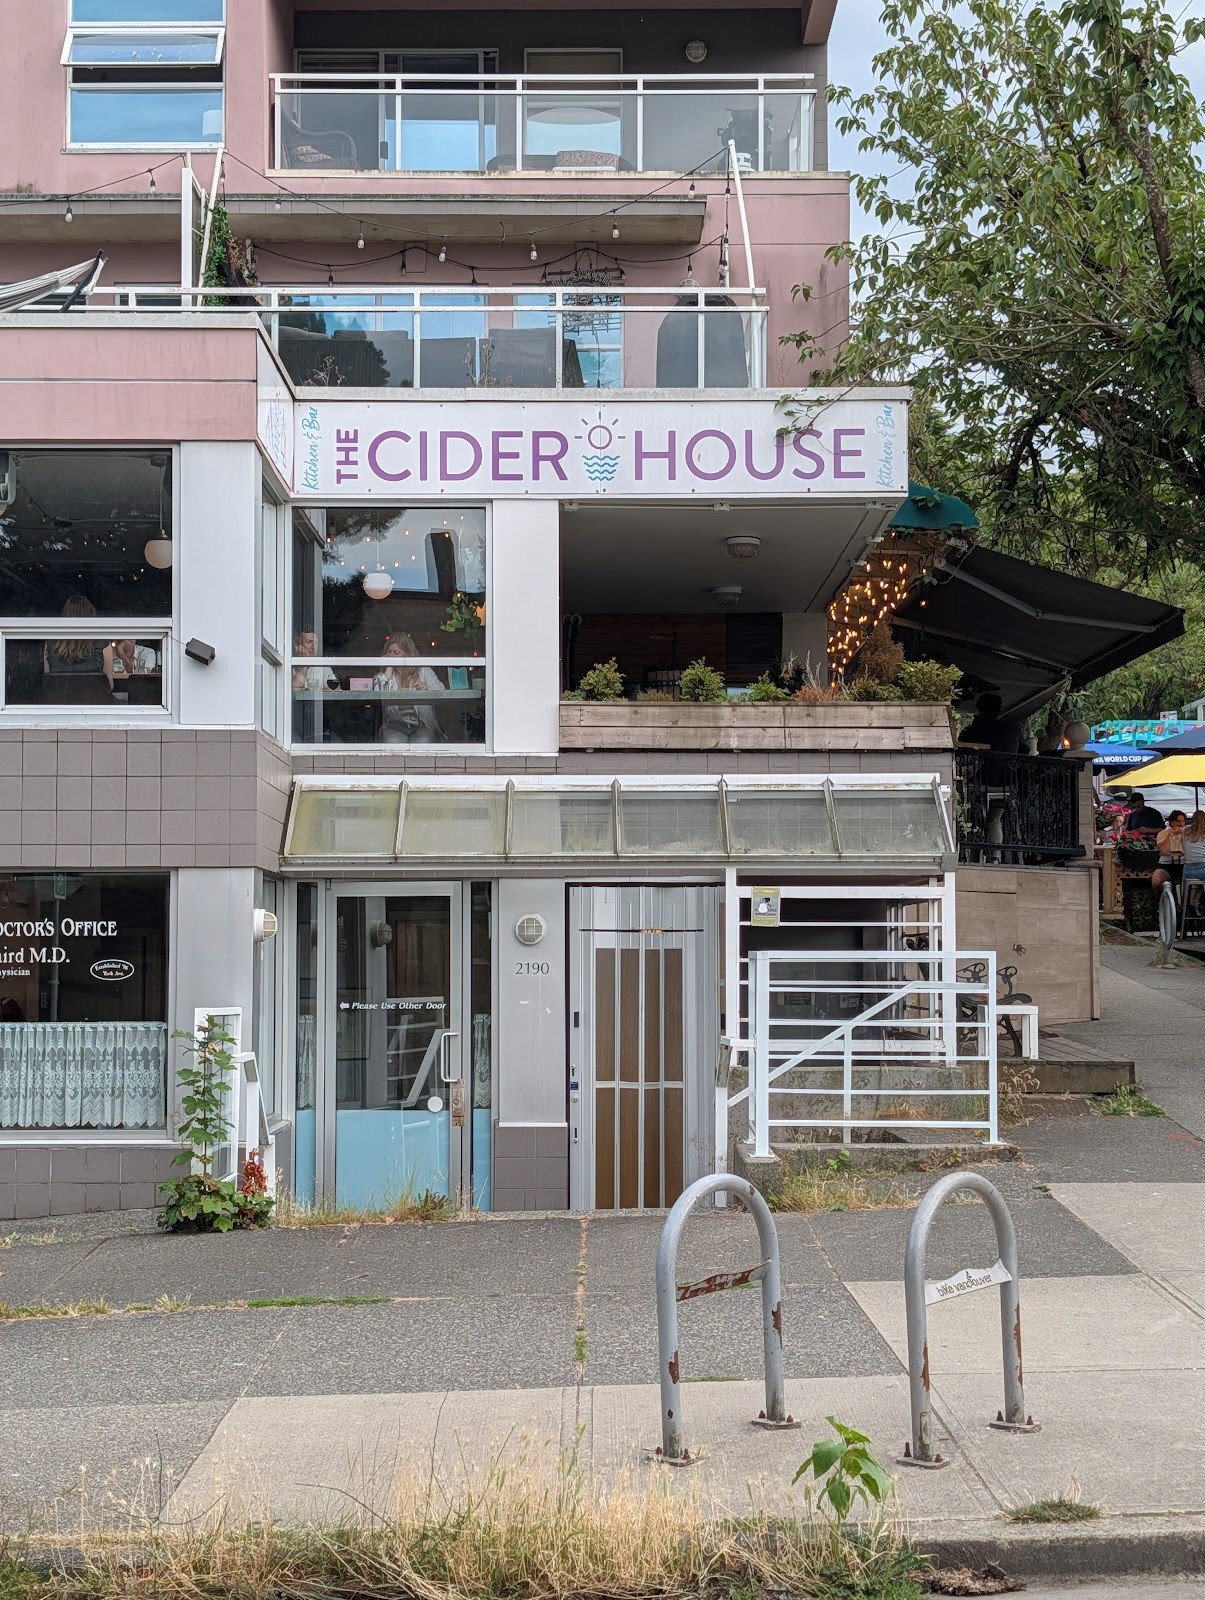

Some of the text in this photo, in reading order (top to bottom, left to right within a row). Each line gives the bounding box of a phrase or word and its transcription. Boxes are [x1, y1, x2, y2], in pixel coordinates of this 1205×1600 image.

[302, 405, 320, 431] Bar
[876, 403, 894, 430] Bar
[301, 441, 320, 490] Kitchen
[336, 428, 866, 484] THE CIDER HOUSE
[876, 439, 894, 488] Kitchen
[61, 917, 118, 937] OFFICE
[29, 947, 70, 963] M.D.
[0, 966, 31, 979] ysician
[515, 962, 550, 975] 2190
[351, 1002, 446, 1010] Please Use Other Door
[936, 1282, 954, 1297] bike
